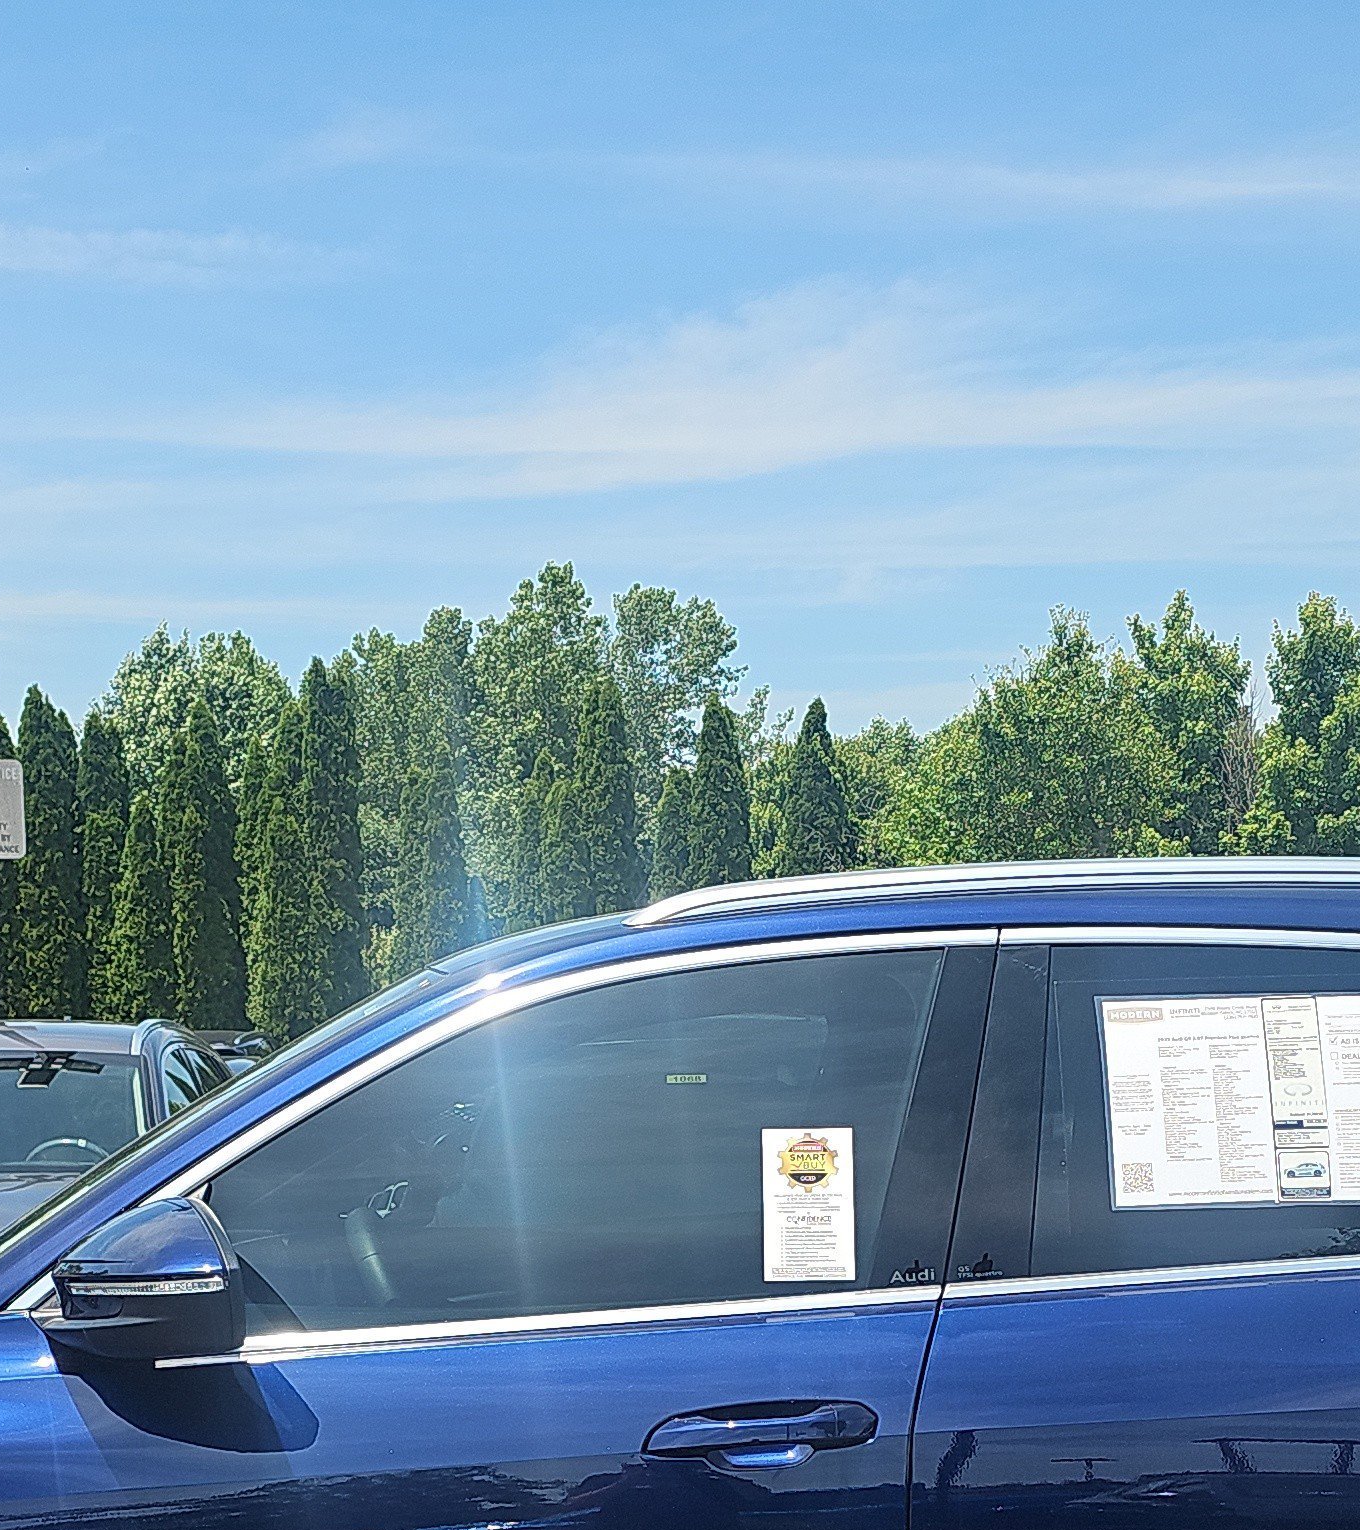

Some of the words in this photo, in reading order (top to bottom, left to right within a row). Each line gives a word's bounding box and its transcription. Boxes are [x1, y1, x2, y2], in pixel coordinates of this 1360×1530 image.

[1108, 1009, 1161, 1021] MODERN
[790, 1153, 826, 1161] SMART
[803, 1161, 826, 1169] BUY
[890, 1268, 935, 1284] Audi
